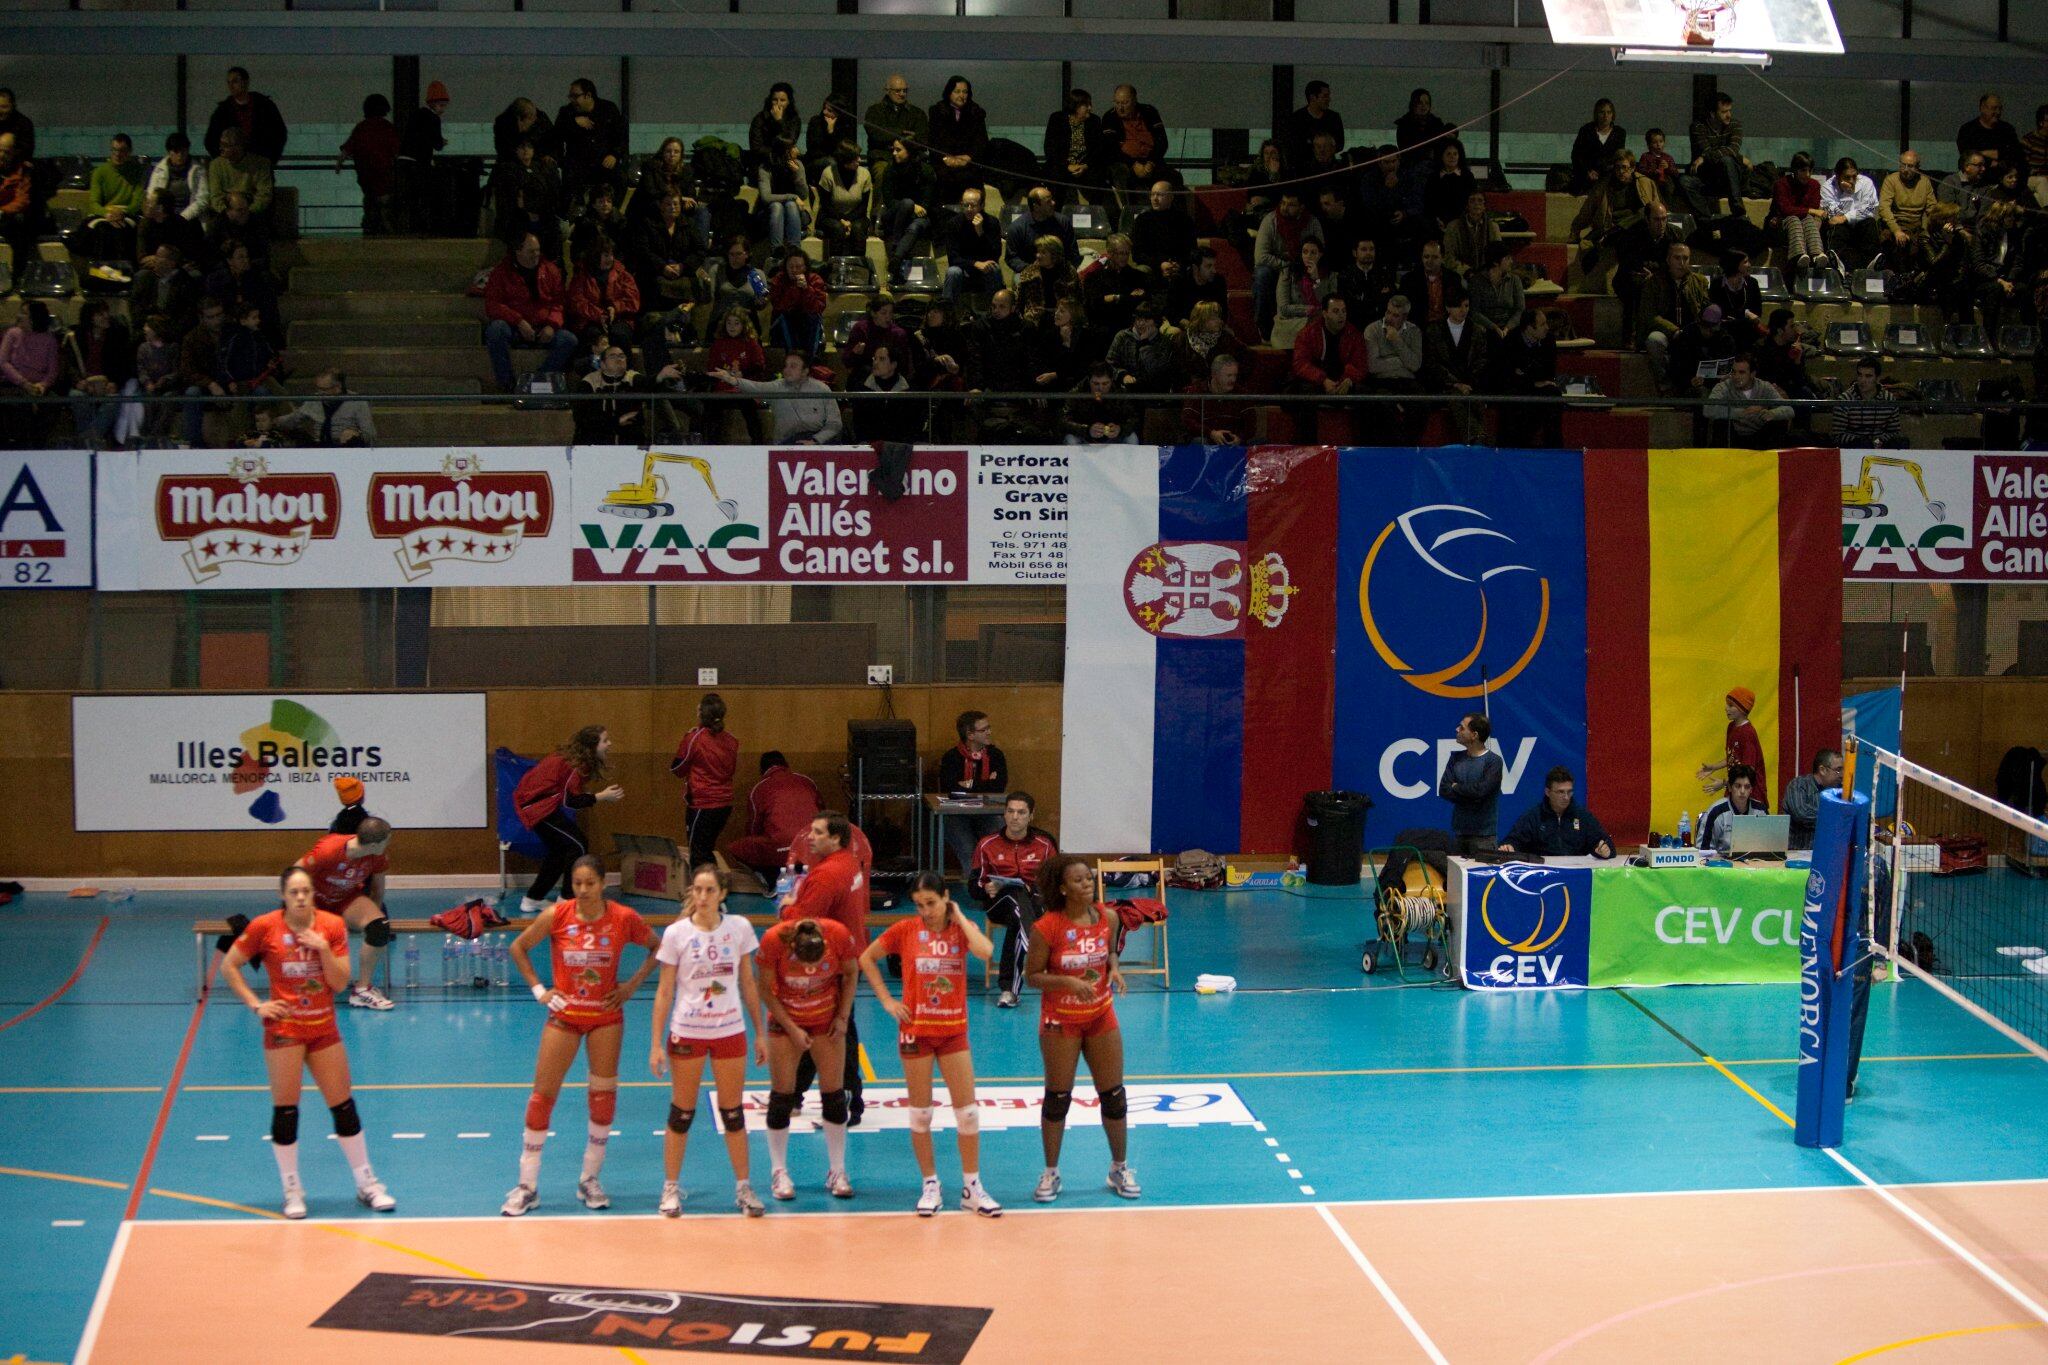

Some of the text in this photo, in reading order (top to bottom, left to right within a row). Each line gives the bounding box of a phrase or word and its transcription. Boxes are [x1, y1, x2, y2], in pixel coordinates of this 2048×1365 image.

[778, 461, 958, 496] Valerno
[977, 472, 984, 484] i
[168, 481, 328, 524] Mahou
[380, 481, 541, 522] Mahou
[1005, 490, 1068, 503] Grave
[778, 500, 872, 537] Allés
[993, 508, 1032, 521] Son
[1002, 531, 1018, 539] C/
[989, 541, 1067, 549] Tels. 971 48
[778, 540, 954, 574] Canet s.l.
[993, 551, 1064, 559] Fax 971 48
[14, 562, 52, 583] 82
[1029, 561, 1053, 569] 656
[177, 740, 383, 769] Illes Balears
[149, 772, 217, 785] MALLORCA
[221, 772, 283, 784] MENORCA
[288, 772, 321, 784] IBIZA
[1655, 854, 1695, 864] MONDO
[1655, 905, 1743, 945] CEV
[582, 933, 596, 950] 2
[928, 940, 949, 956] 10
[1076, 938, 1097, 953] 15
[707, 945, 718, 961] 6
[1489, 954, 1564, 985] CEV
[591, 1312, 932, 1354] FUSIÓN
